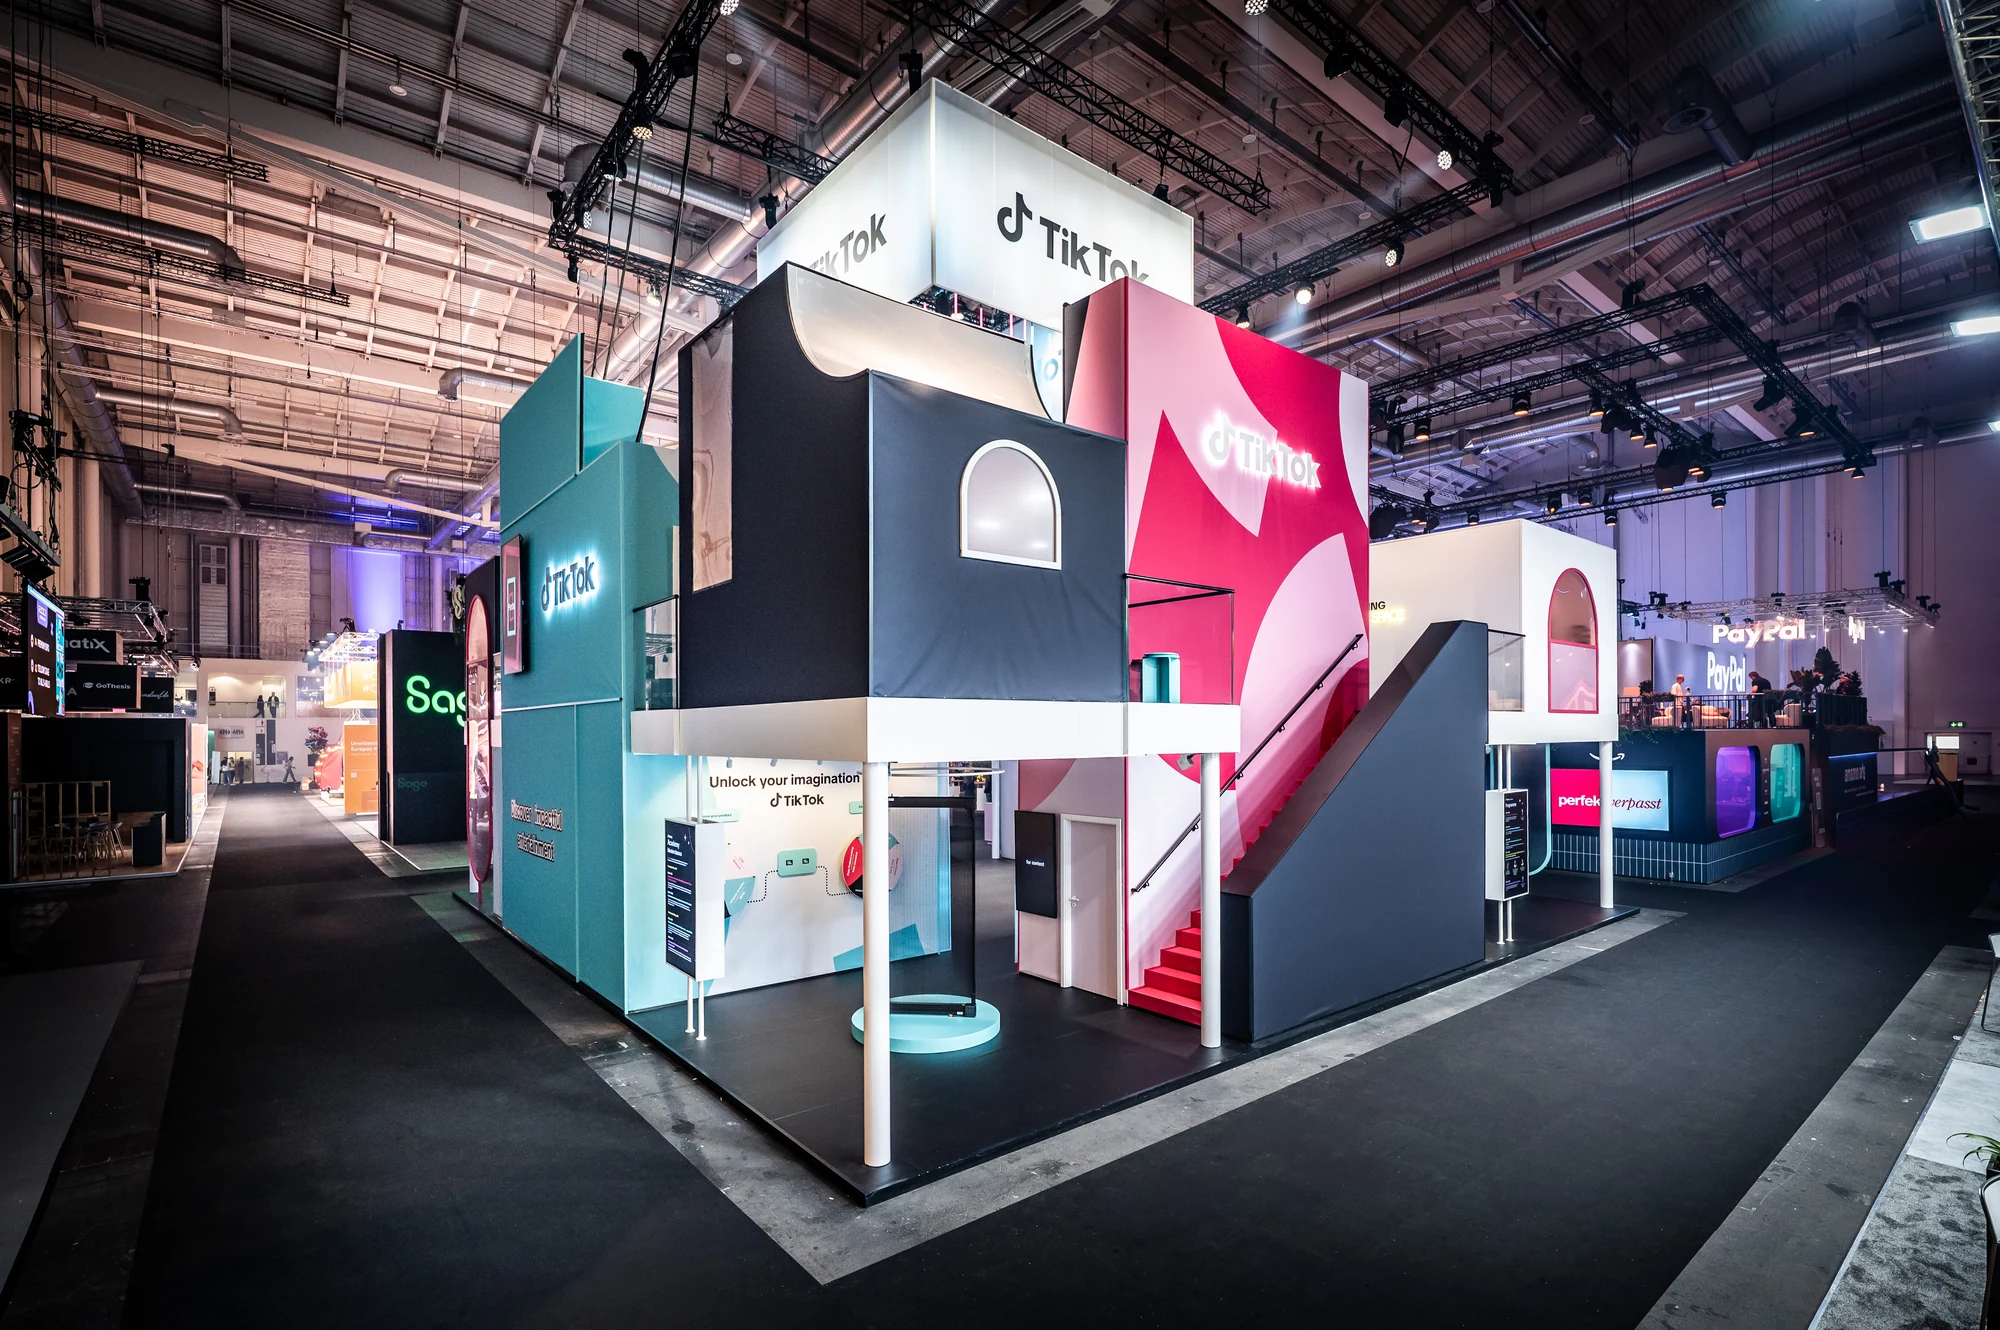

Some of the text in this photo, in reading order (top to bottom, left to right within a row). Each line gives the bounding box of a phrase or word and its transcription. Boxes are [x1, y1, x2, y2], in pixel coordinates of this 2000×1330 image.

[809, 213, 887, 279] ikTok
[1240, 432, 1322, 489] TikTok
[553, 556, 595, 606] TikTok
[1369, 601, 1386, 611] NG
[1712, 619, 1806, 648] PayPal
[1707, 651, 1746, 702] PayPal
[406, 675, 467, 728] Sa
[397, 777, 428, 792] Sage
[709, 772, 860, 789] Unlock your imagination
[511, 799, 563, 832] Discover impactful
[784, 794, 825, 807] TikTok
[1558, 794, 1601, 807] perfek
[517, 832, 554, 862] entertainment
